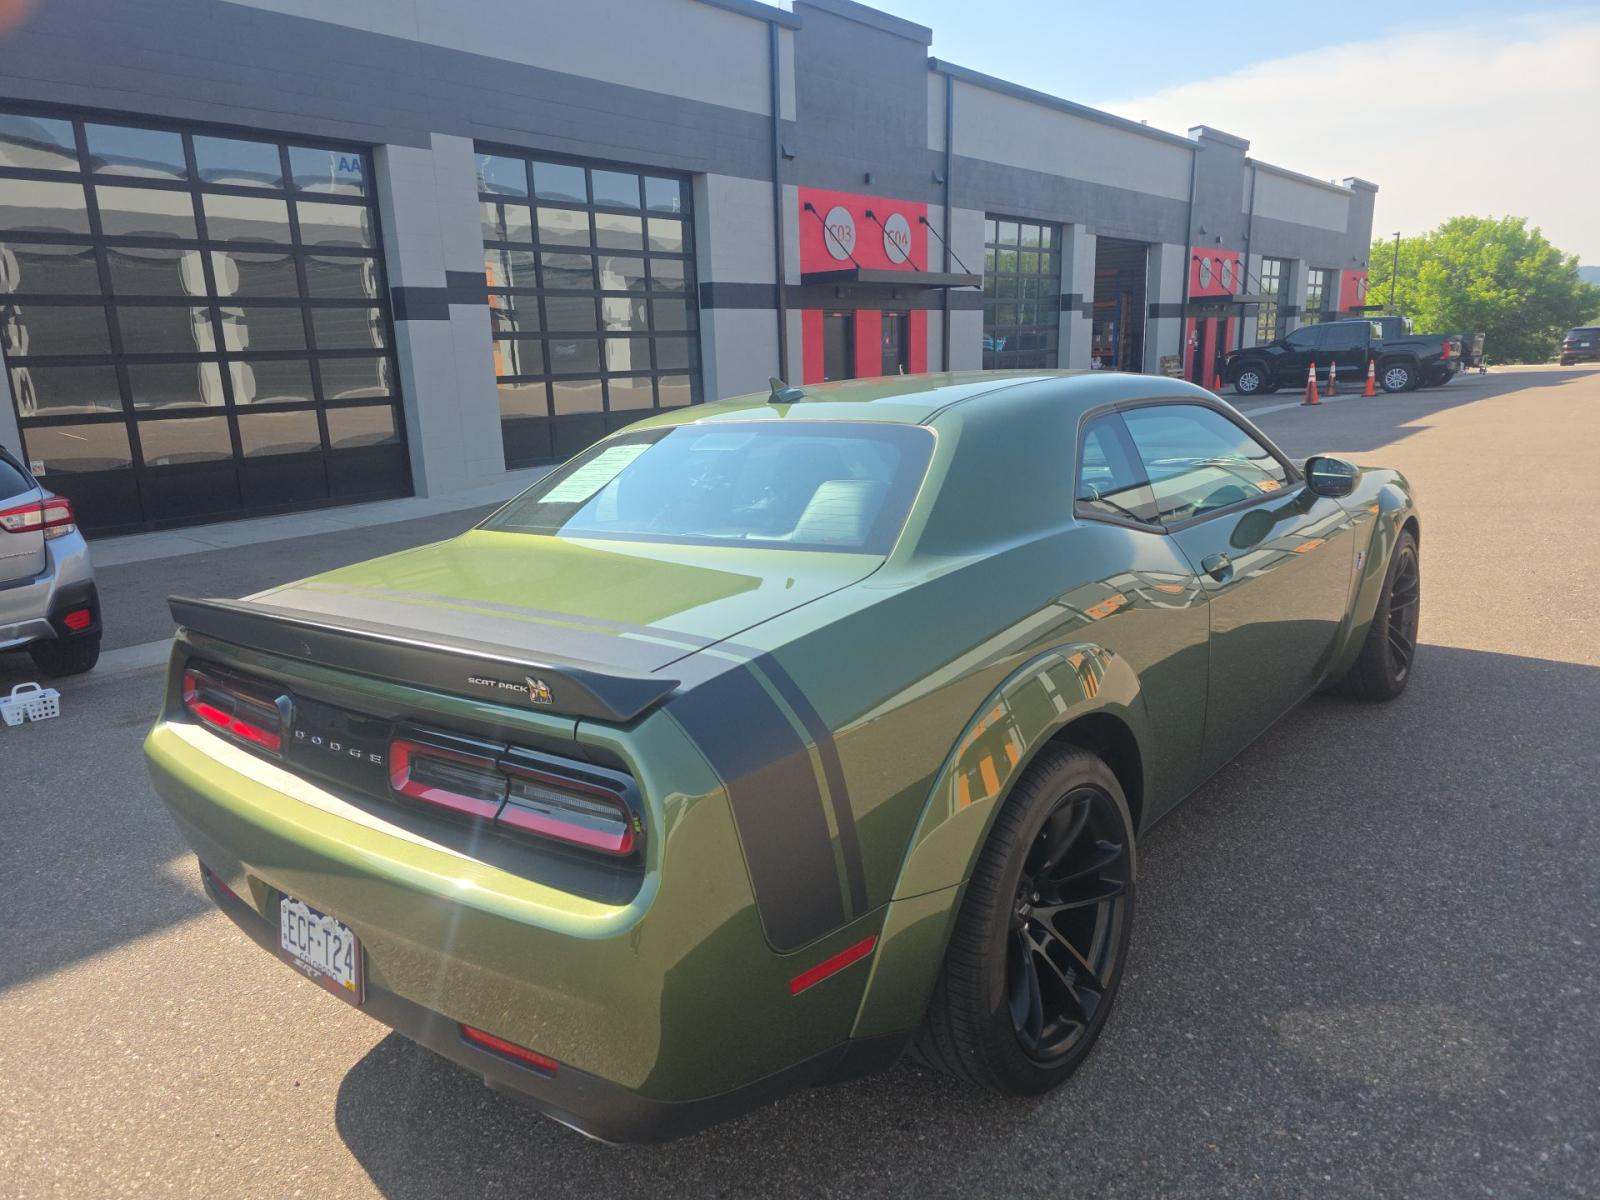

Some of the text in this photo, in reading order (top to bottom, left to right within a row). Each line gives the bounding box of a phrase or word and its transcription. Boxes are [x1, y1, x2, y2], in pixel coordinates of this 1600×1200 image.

[467, 677, 528, 693] SCAT PACK
[295, 730, 382, 766] DODGE
[299, 952, 338, 981] COLORADO
